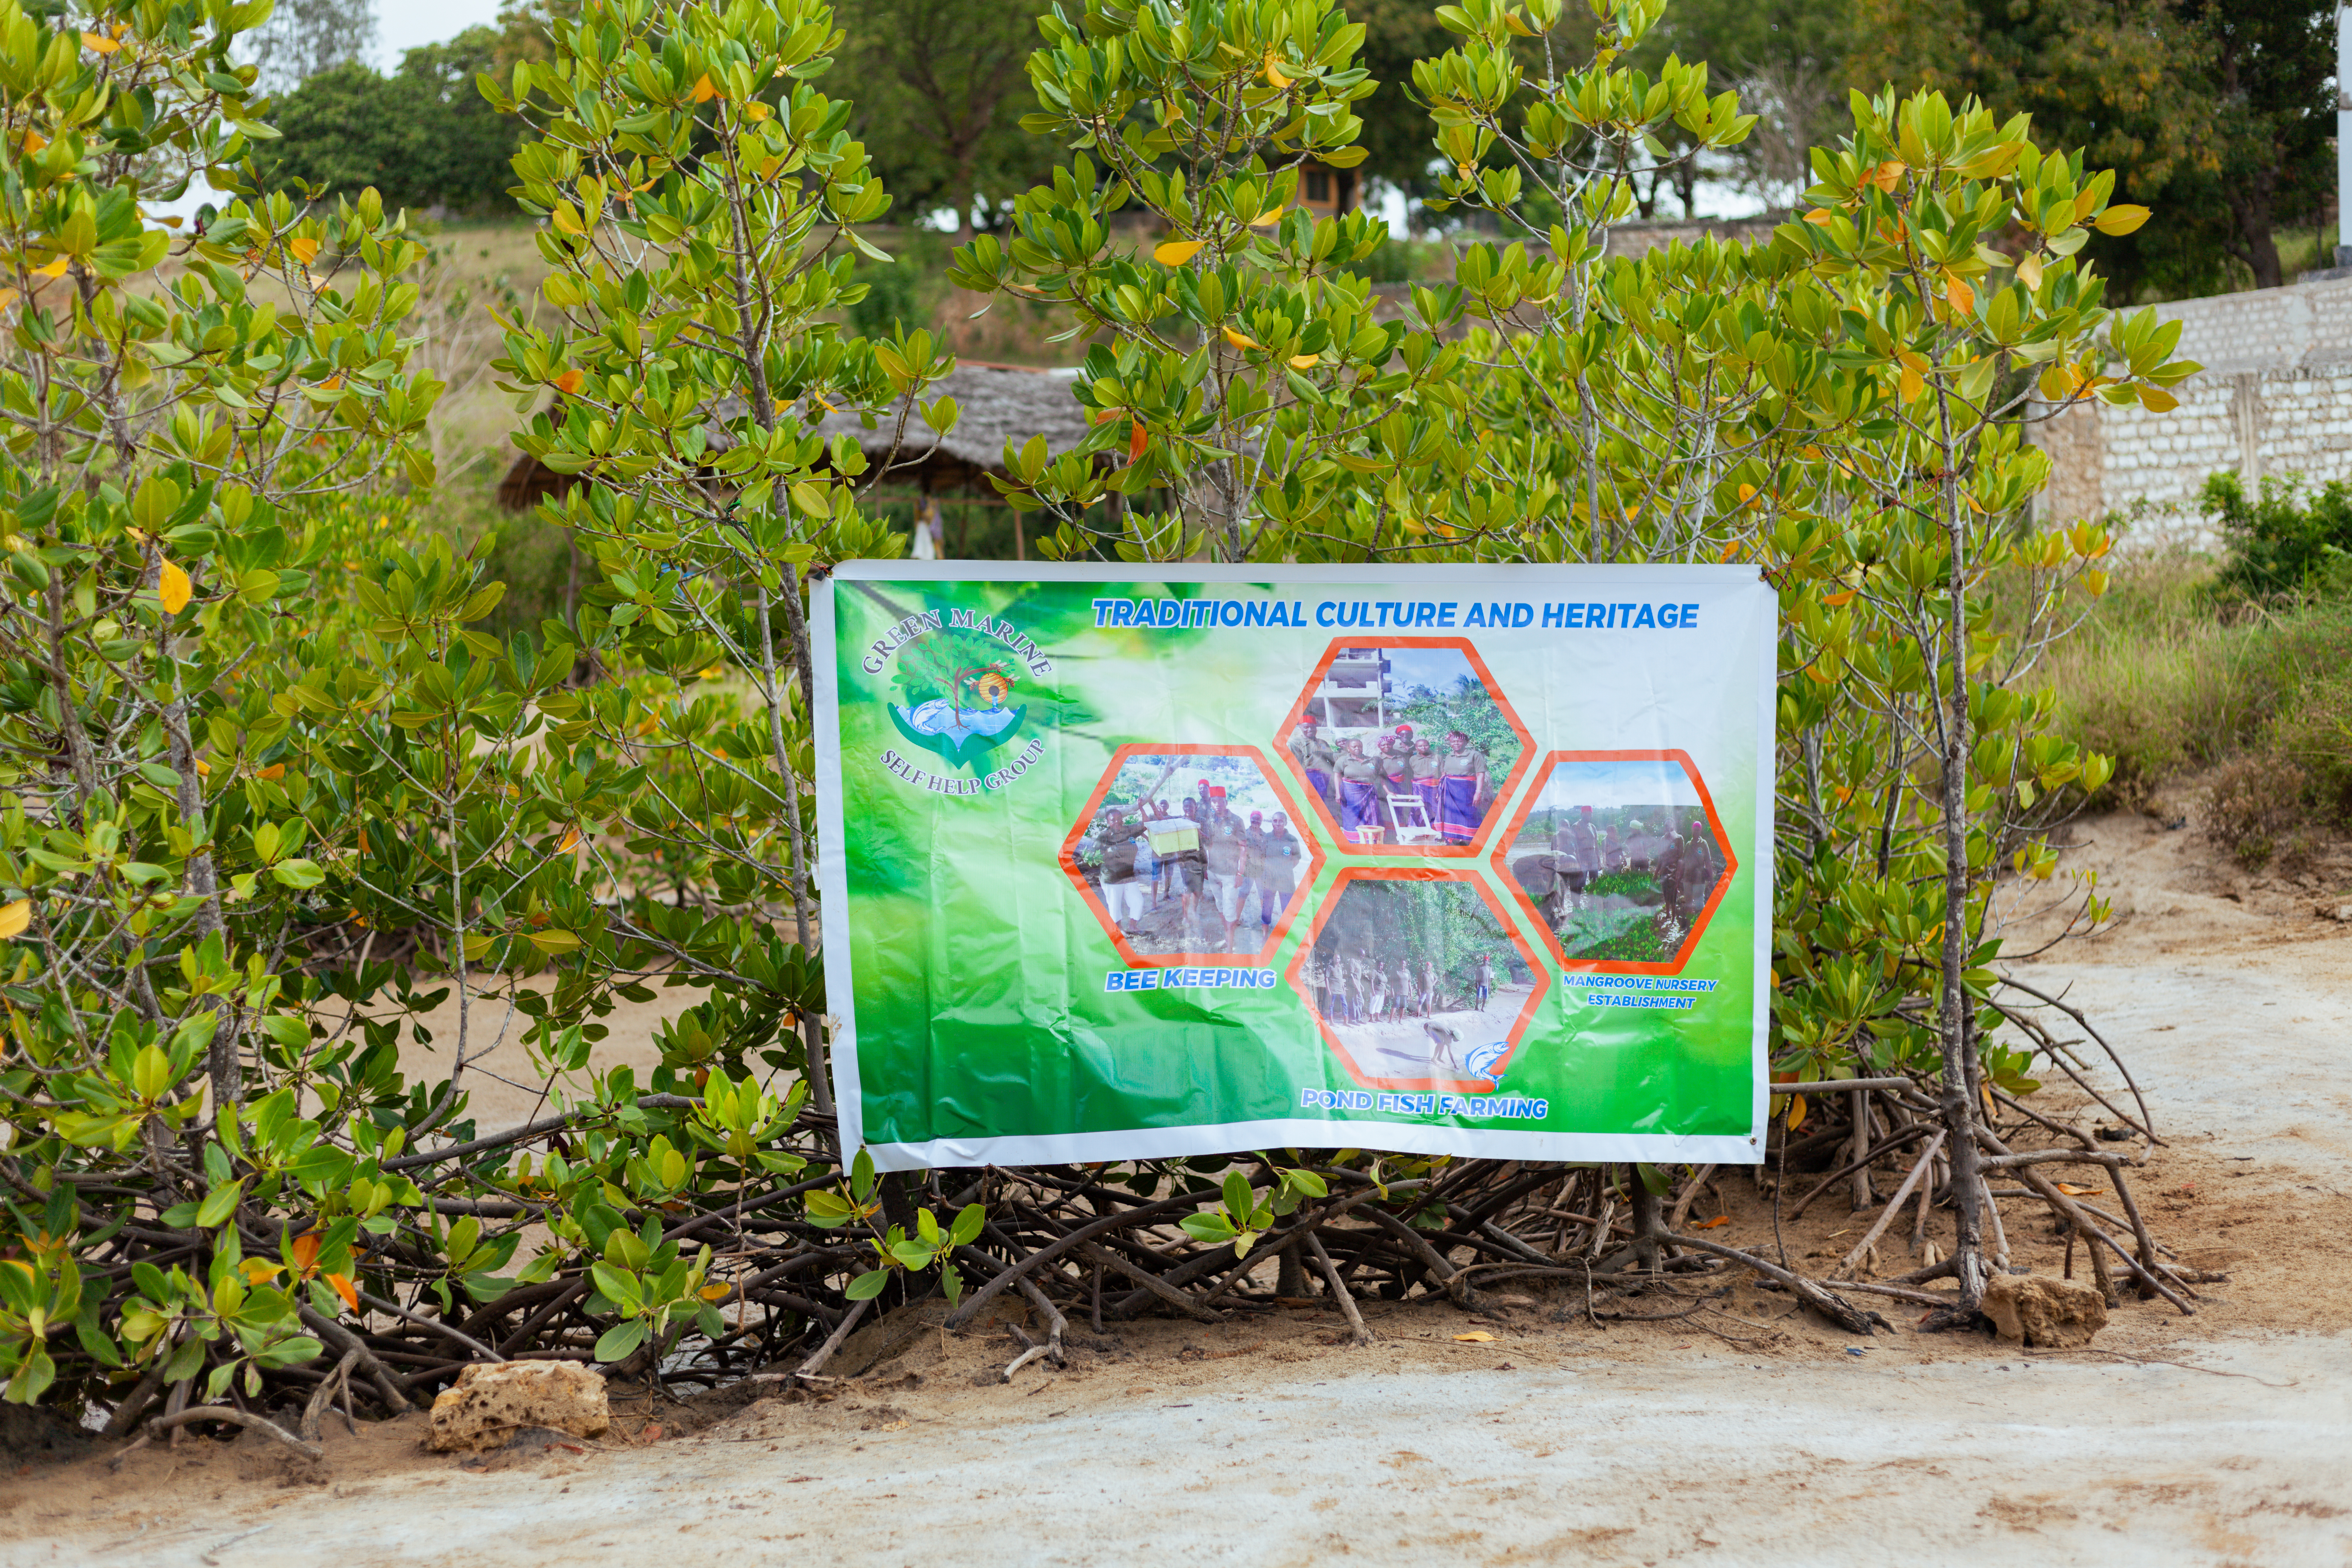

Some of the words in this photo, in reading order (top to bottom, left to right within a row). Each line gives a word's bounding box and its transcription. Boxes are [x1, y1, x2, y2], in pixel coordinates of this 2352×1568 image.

[1093, 599, 1308, 627] TRADITIONAL
[1315, 601, 1458, 628] CULTURE
[1462, 602, 1534, 629] AND
[1541, 602, 1700, 629] HERITAGE
[862, 609, 942, 675] GREEN
[949, 609, 1052, 677] MARINE
[880, 750, 926, 784] SELF
[926, 774, 981, 795] HELP
[985, 738, 1045, 790] GROUP
[1106, 970, 1158, 990] BEE
[1163, 968, 1276, 990] KEEPING
[1564, 975, 1653, 990] MANGROOVE
[1656, 979, 1718, 991] NURSERY
[1588, 994, 1696, 1009] ESTABLISHMENT
[1302, 1089, 1374, 1109] POND
[1377, 1094, 1436, 1114] FISH
[1439, 1096, 1549, 1119] FARMING
